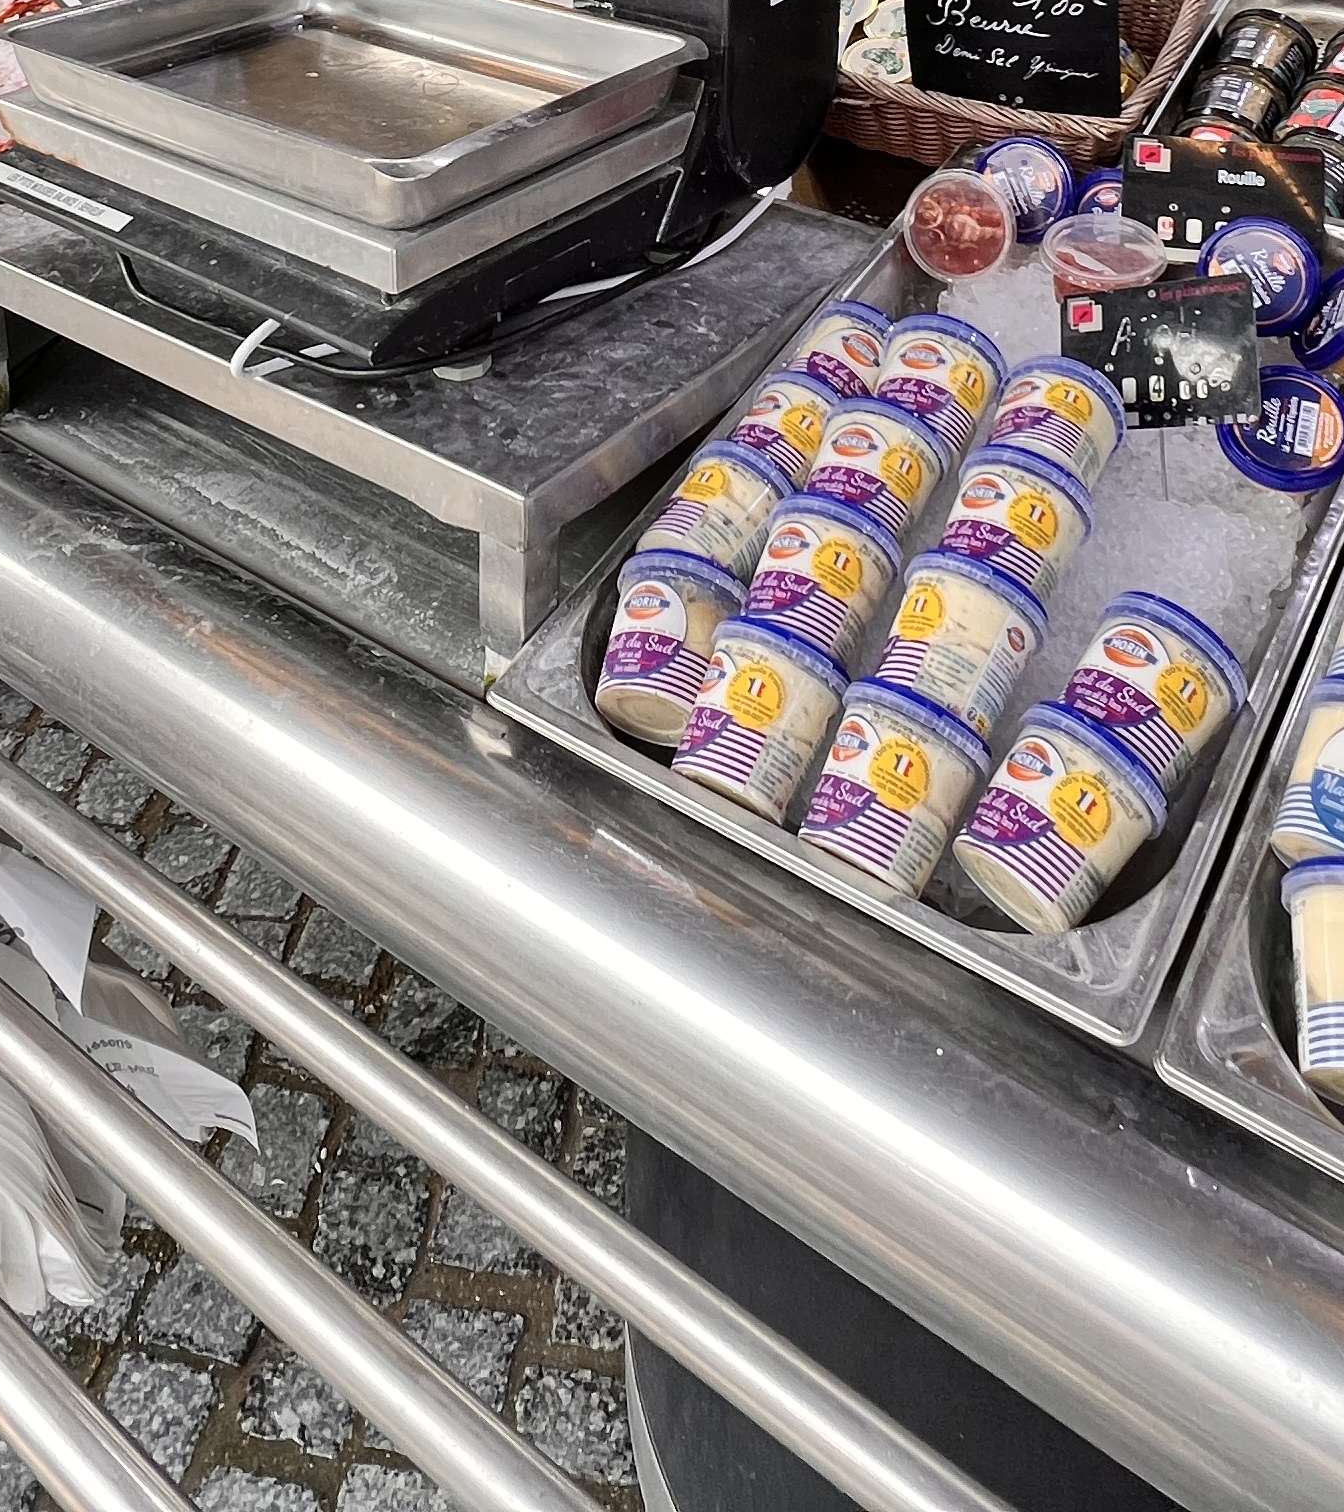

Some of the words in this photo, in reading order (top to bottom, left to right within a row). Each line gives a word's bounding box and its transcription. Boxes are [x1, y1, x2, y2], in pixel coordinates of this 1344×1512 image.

[935, 33, 981, 61] Demi
[985, 47, 1017, 69] Sel
[1217, 168, 1266, 187] Rouille
[1256, 396, 1282, 445] Rouille
[975, 523, 1010, 545] Sud
[780, 573, 814, 595] Sud
[628, 596, 660, 608] MORIN
[625, 632, 643, 649] du
[644, 634, 678, 656] Sud
[1111, 638, 1148, 660] MORIN
[1094, 676, 1116, 694] du
[1116, 686, 1155, 717] Sud
[696, 710, 727, 730] Sud
[835, 782, 871, 808] Sud
[992, 792, 1010, 810] du
[1009, 801, 1048, 833] Sud
